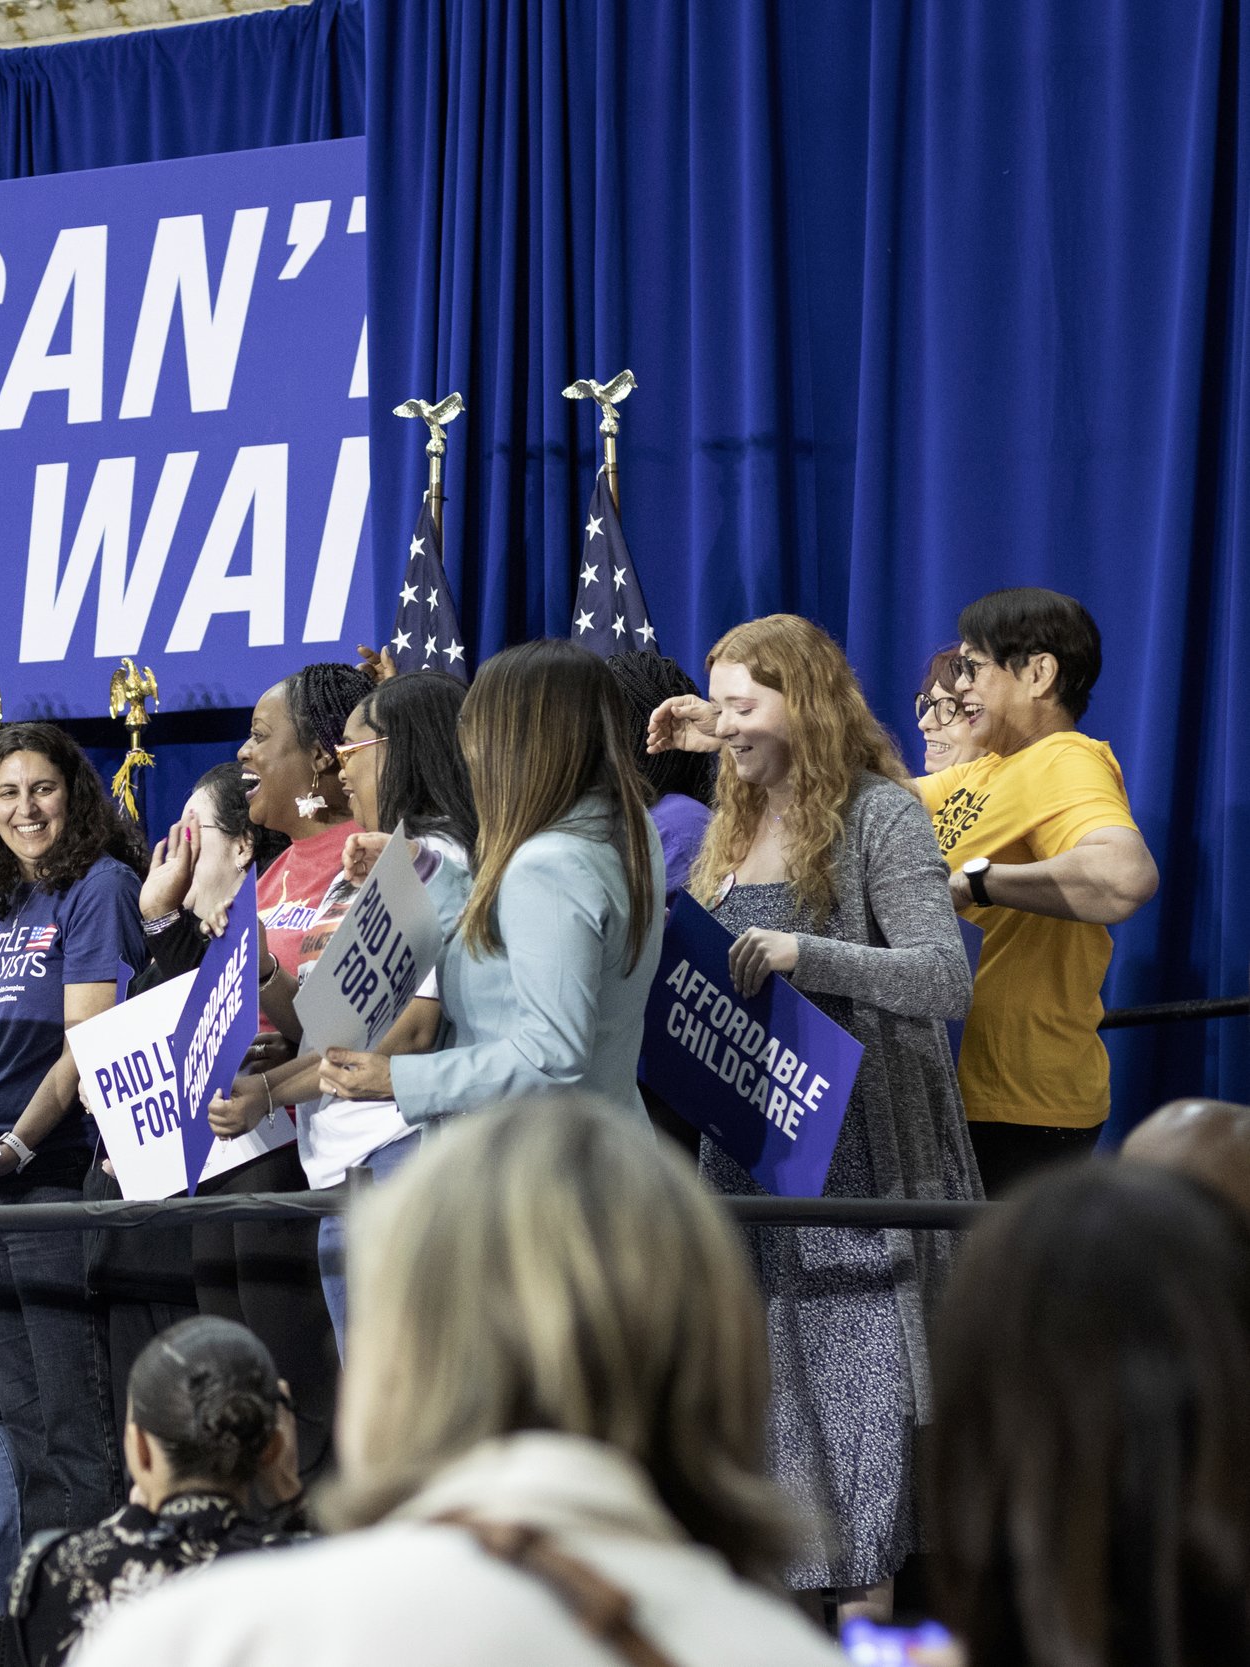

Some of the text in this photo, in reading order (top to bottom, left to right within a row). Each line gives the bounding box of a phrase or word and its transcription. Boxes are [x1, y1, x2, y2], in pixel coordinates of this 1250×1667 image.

[19, 436, 370, 663] WAI
[333, 941, 378, 1014] FOR
[354, 878, 392, 956] PAID
[95, 1050, 153, 1109] PAID
[183, 928, 249, 1098] AFFORDABLE
[189, 975, 243, 1120] CHILDCARE
[666, 959, 830, 1112] AFFORDABLE
[667, 1002, 805, 1141] CHILDCARE
[131, 1089, 181, 1146] FOR
